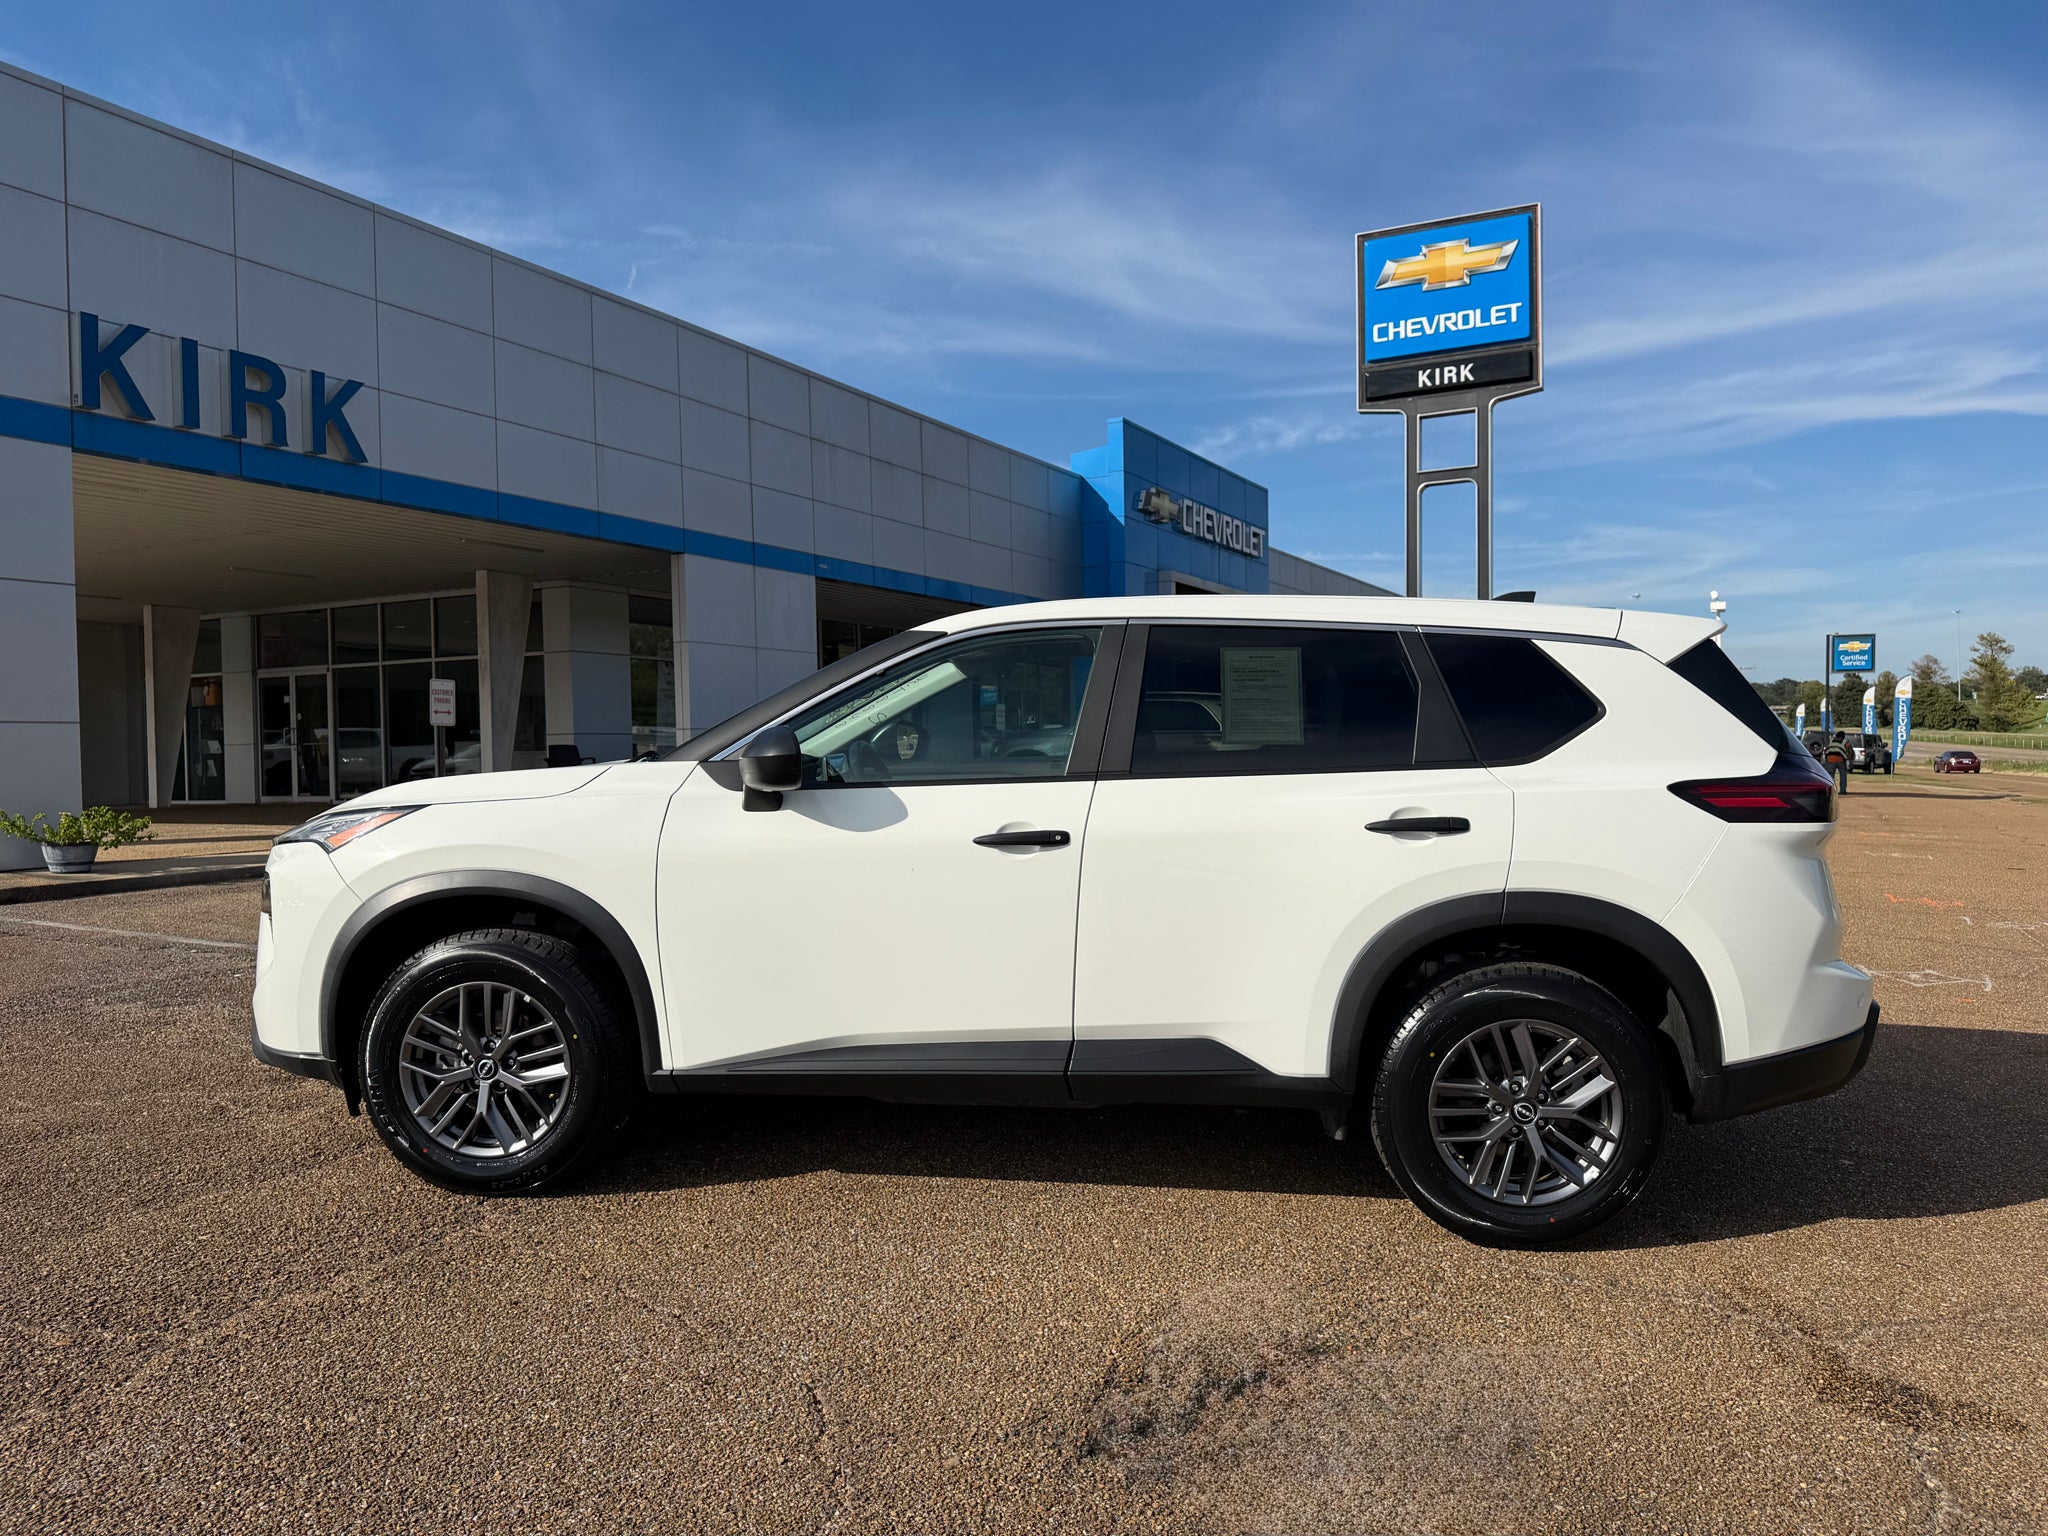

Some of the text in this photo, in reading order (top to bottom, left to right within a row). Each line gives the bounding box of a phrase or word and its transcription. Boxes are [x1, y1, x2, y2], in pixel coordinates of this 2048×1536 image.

[1373, 302, 1522, 343] CHEVROLET
[78, 311, 369, 463] KIRK
[1418, 363, 1475, 388] KIRK
[1182, 498, 1266, 558] CHEVROLET
